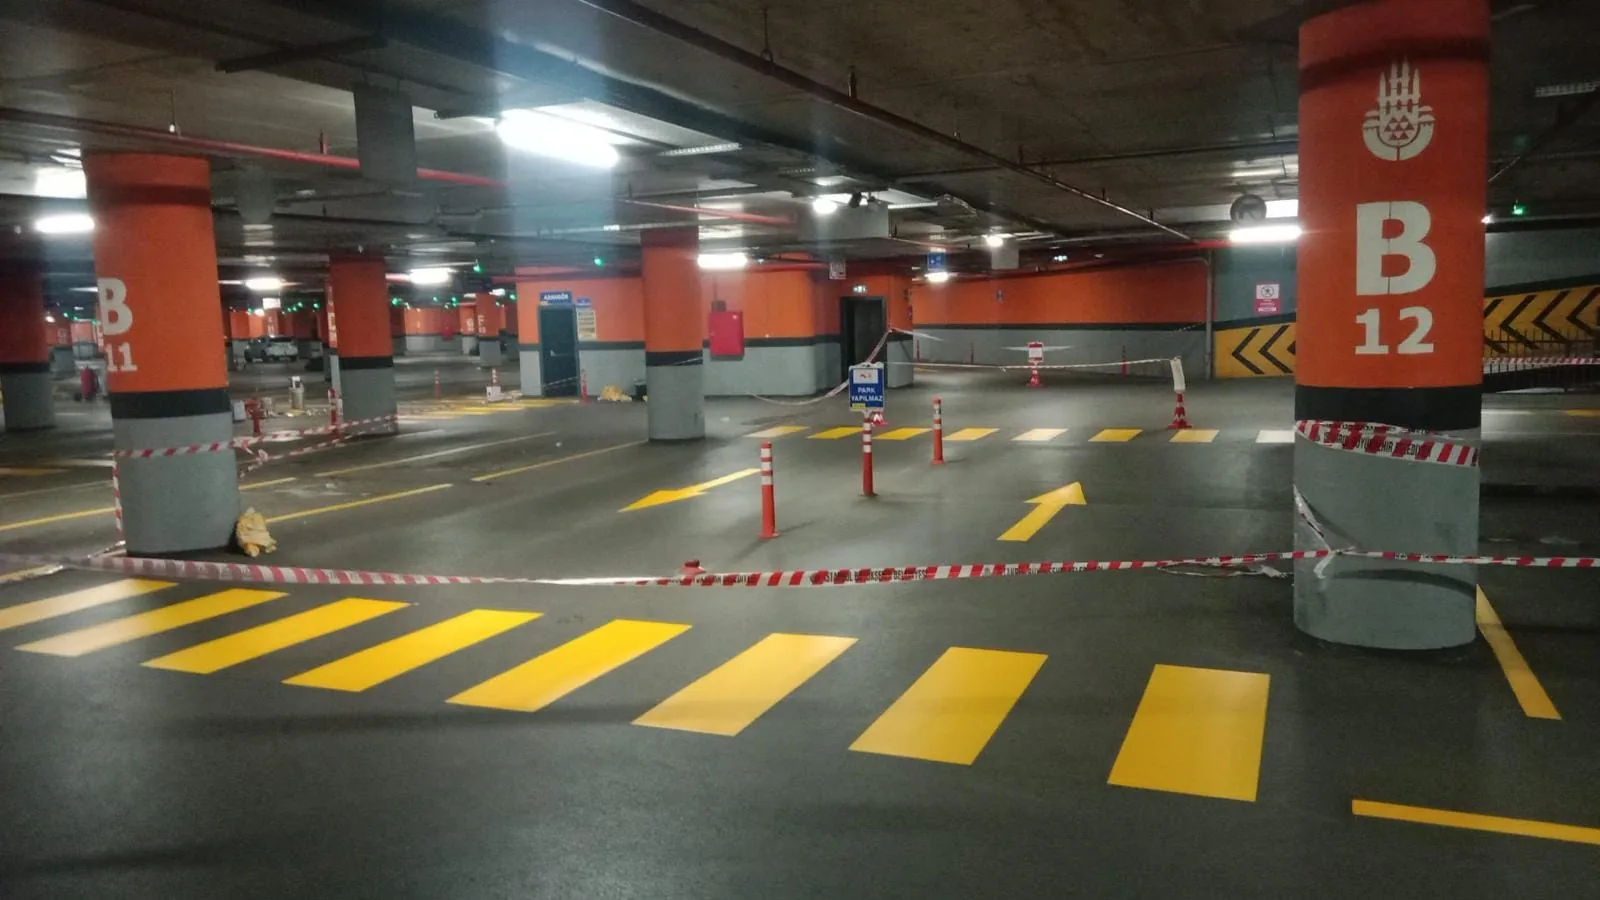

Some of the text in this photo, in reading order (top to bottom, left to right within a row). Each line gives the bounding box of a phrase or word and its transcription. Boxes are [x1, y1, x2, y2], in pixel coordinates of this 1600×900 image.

[1356, 201, 1436, 295] B
[97, 278, 133, 335] B
[1355, 306, 1434, 355] 12
[105, 341, 138, 372] 11
[857, 386, 876, 394] PARK
